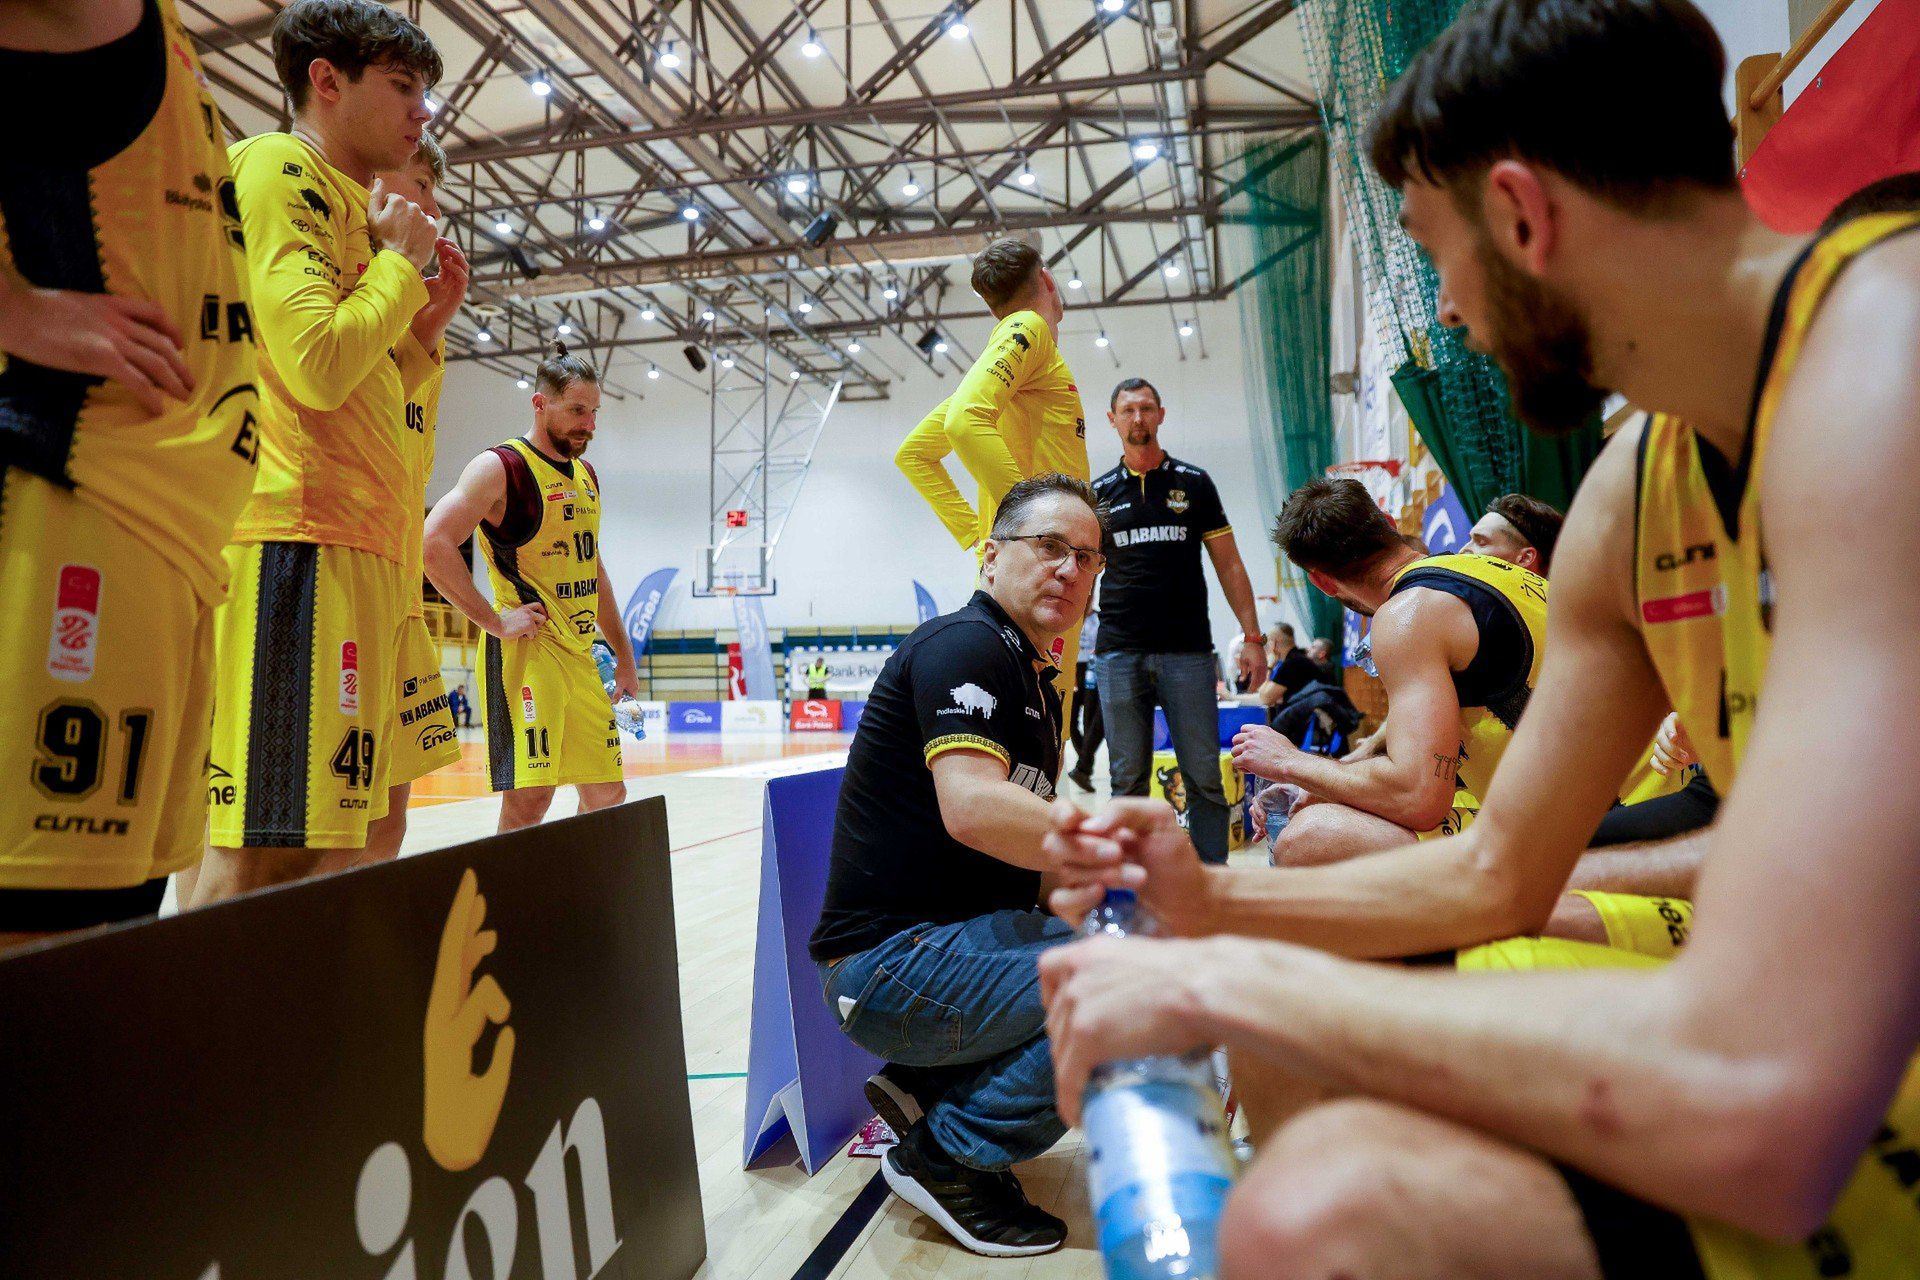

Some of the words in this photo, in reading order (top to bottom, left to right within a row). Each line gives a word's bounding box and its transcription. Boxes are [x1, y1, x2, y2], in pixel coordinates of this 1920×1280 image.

[727, 510, 748, 528] 24
[1129, 525, 1188, 546] ABAKUS
[573, 530, 595, 563] 10
[31, 697, 155, 807] 91
[329, 726, 375, 791] 49
